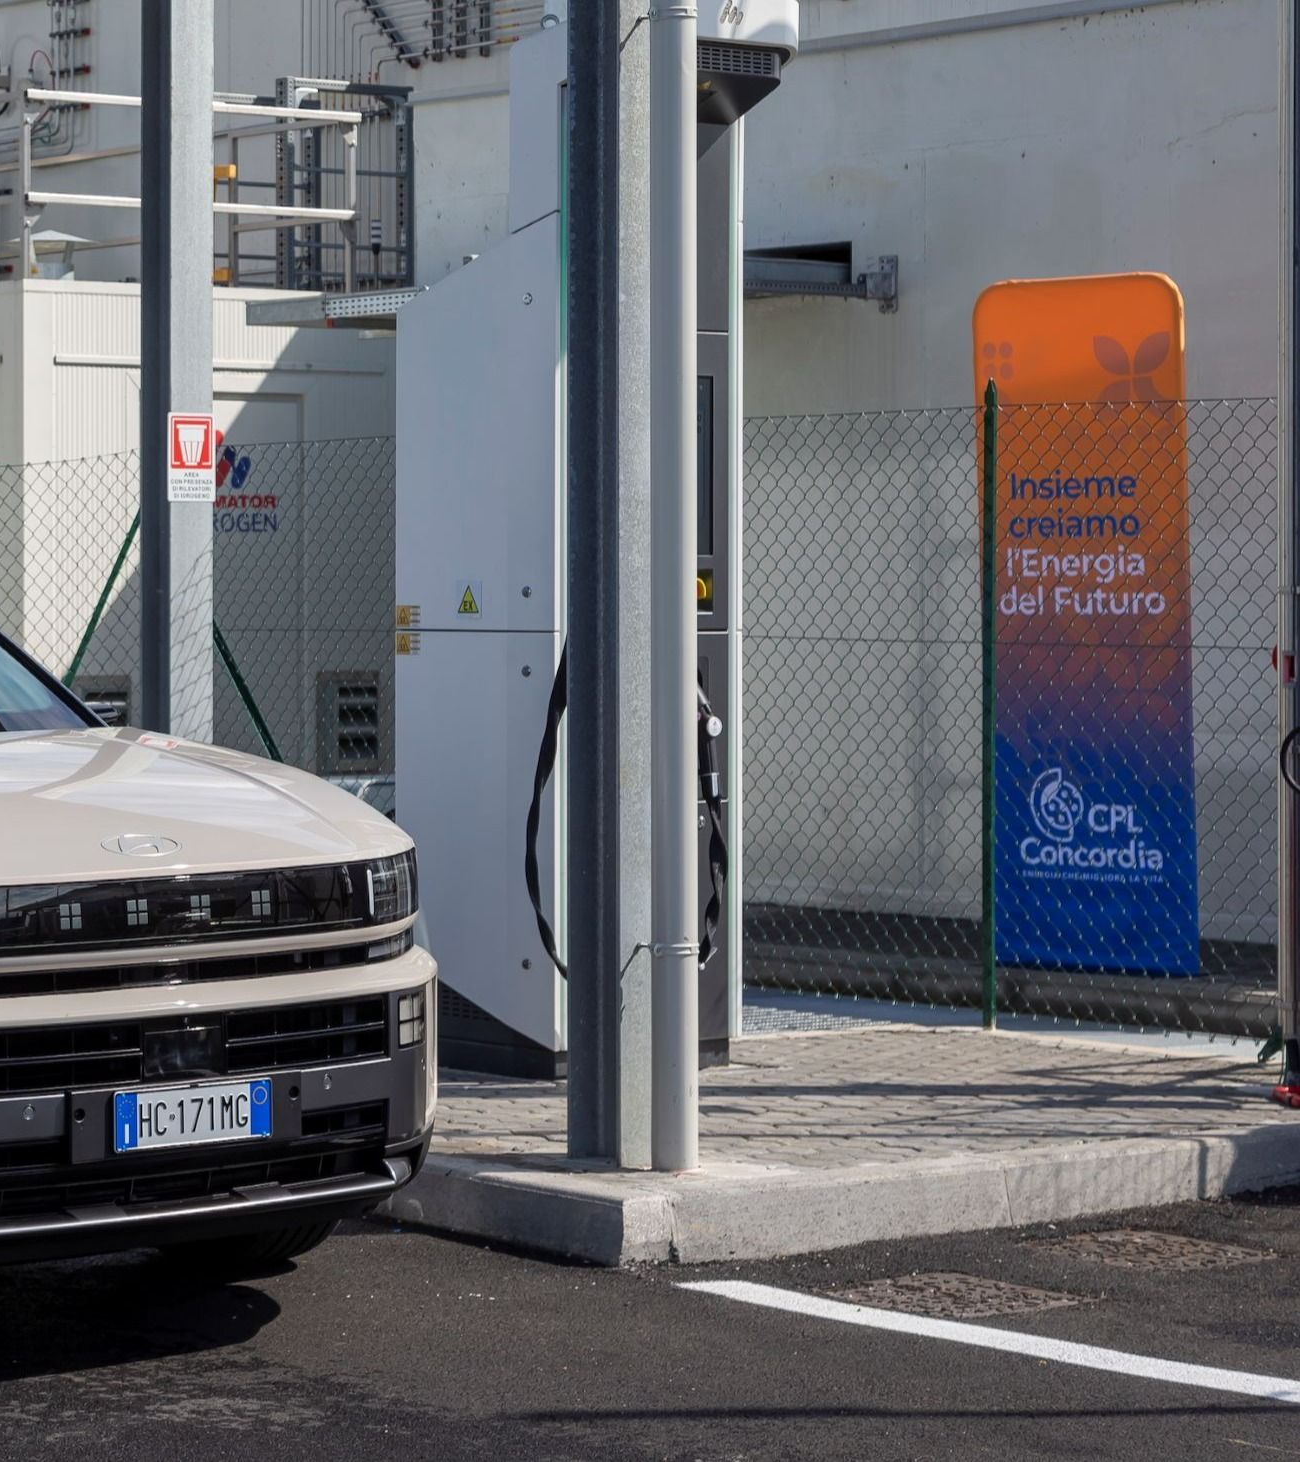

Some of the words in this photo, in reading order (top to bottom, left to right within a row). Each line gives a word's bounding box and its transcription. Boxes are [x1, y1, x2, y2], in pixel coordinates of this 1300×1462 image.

[1010, 469, 1137, 500] Insieme
[1009, 507, 1141, 539] creiamo
[1006, 545, 1146, 584] l'Energia
[463, 601, 473, 611] EX
[1000, 585, 1044, 616] del
[1054, 586, 1166, 616] Futuro
[1088, 804, 1143, 833] CPL
[1020, 837, 1164, 869] Concordia
